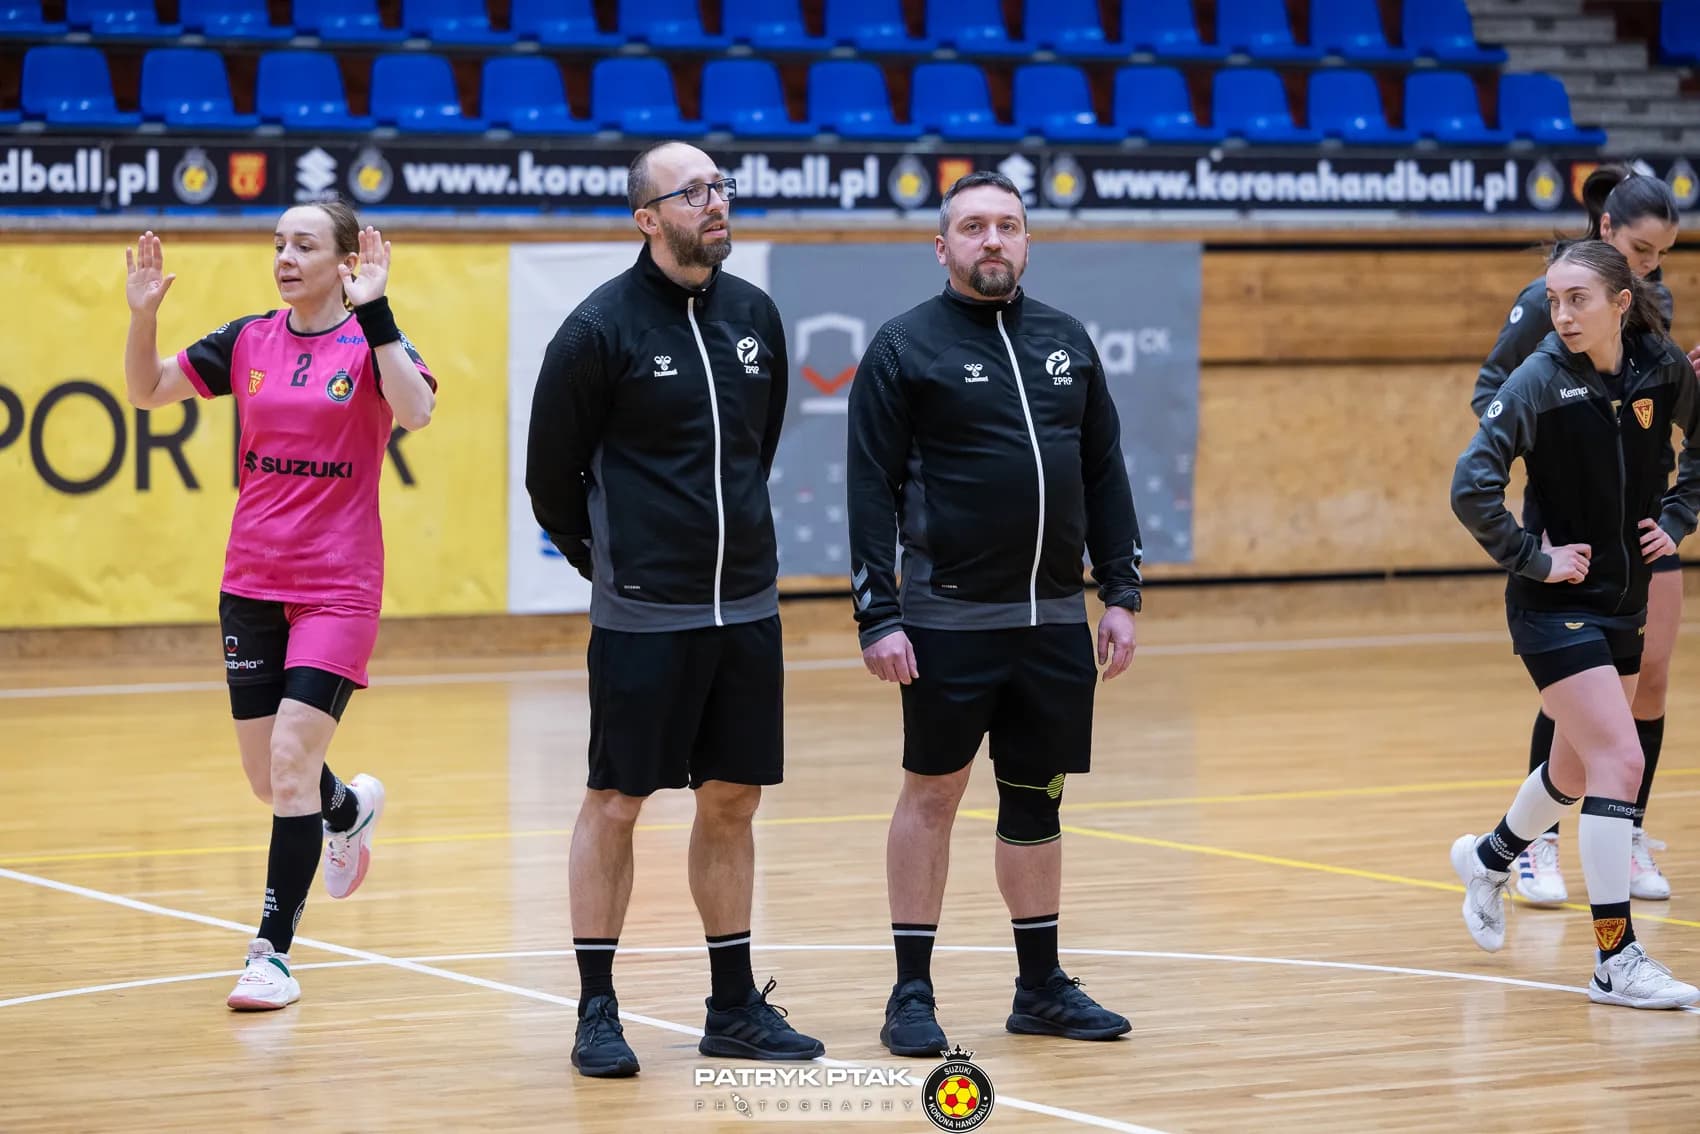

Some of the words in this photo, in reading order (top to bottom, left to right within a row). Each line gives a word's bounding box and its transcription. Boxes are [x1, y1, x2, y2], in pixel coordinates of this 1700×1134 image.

[402, 150, 879, 209] www.korondball.pl
[1093, 157, 1517, 212] www.koronahandball.pl
[290, 353, 312, 387] 2
[1052, 376, 1073, 386] ZPRP
[261, 456, 353, 478] SUZUKI
